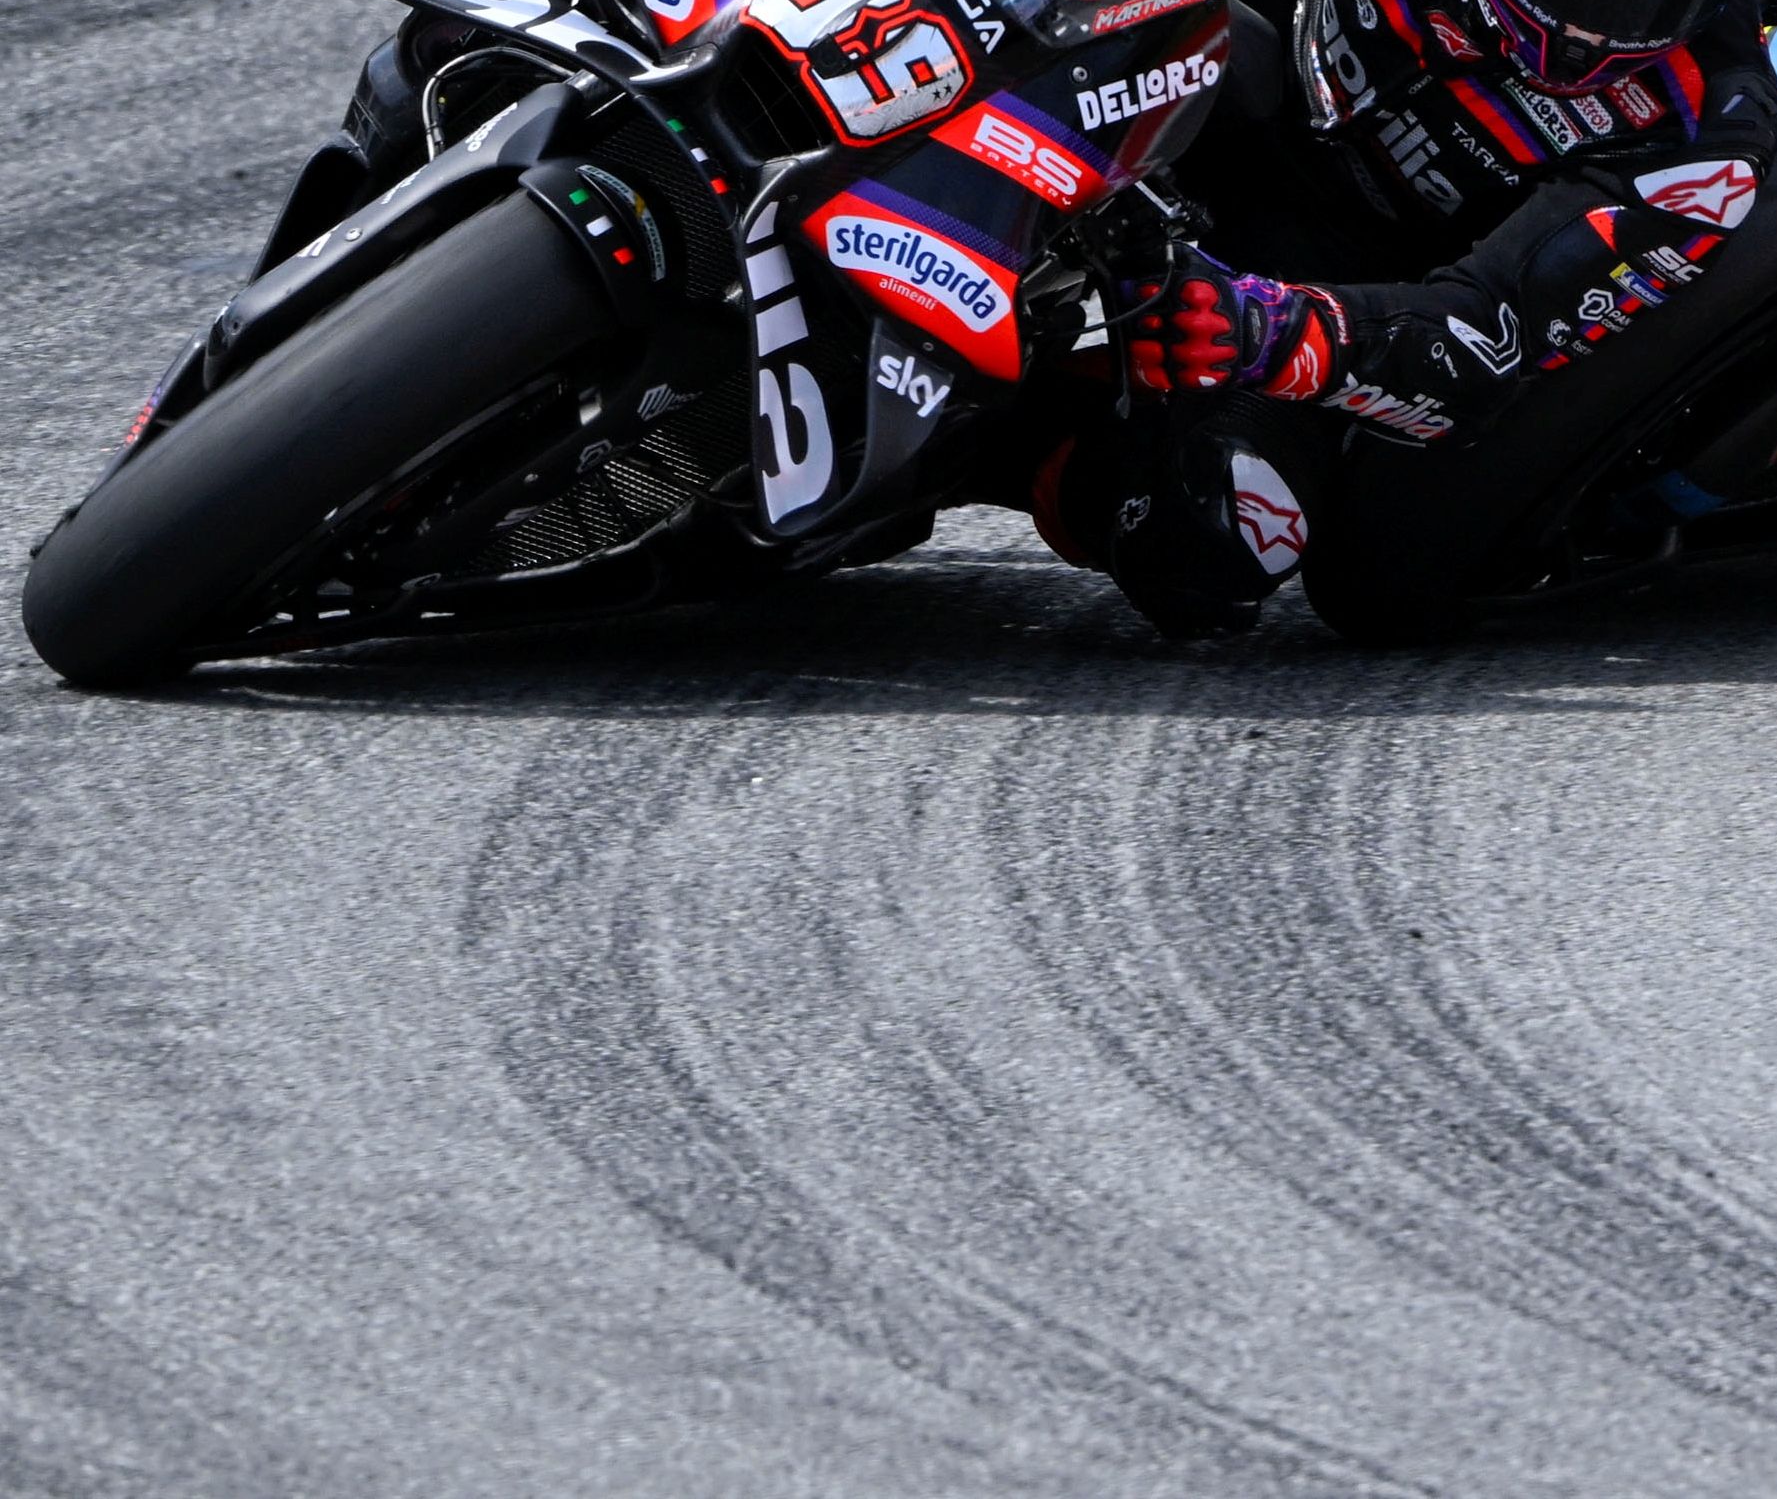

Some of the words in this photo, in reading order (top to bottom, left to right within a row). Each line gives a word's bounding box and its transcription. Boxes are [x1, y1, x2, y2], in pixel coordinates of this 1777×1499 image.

[1532, 6, 1559, 30] Right
[1607, 36, 1646, 51] Breathe
[1076, 55, 1220, 132] DELLORTO
[1572, 95, 1613, 135] strol
[970, 141, 1074, 207] BATTERY
[971, 112, 1083, 195] BS
[1451, 121, 1522, 187] TARGA
[835, 222, 998, 320] sterilgarda
[878, 275, 938, 313] alimenti
[1654, 245, 1705, 285] SC
[876, 350, 953, 418] sky
[1325, 372, 1457, 441] aprilia
